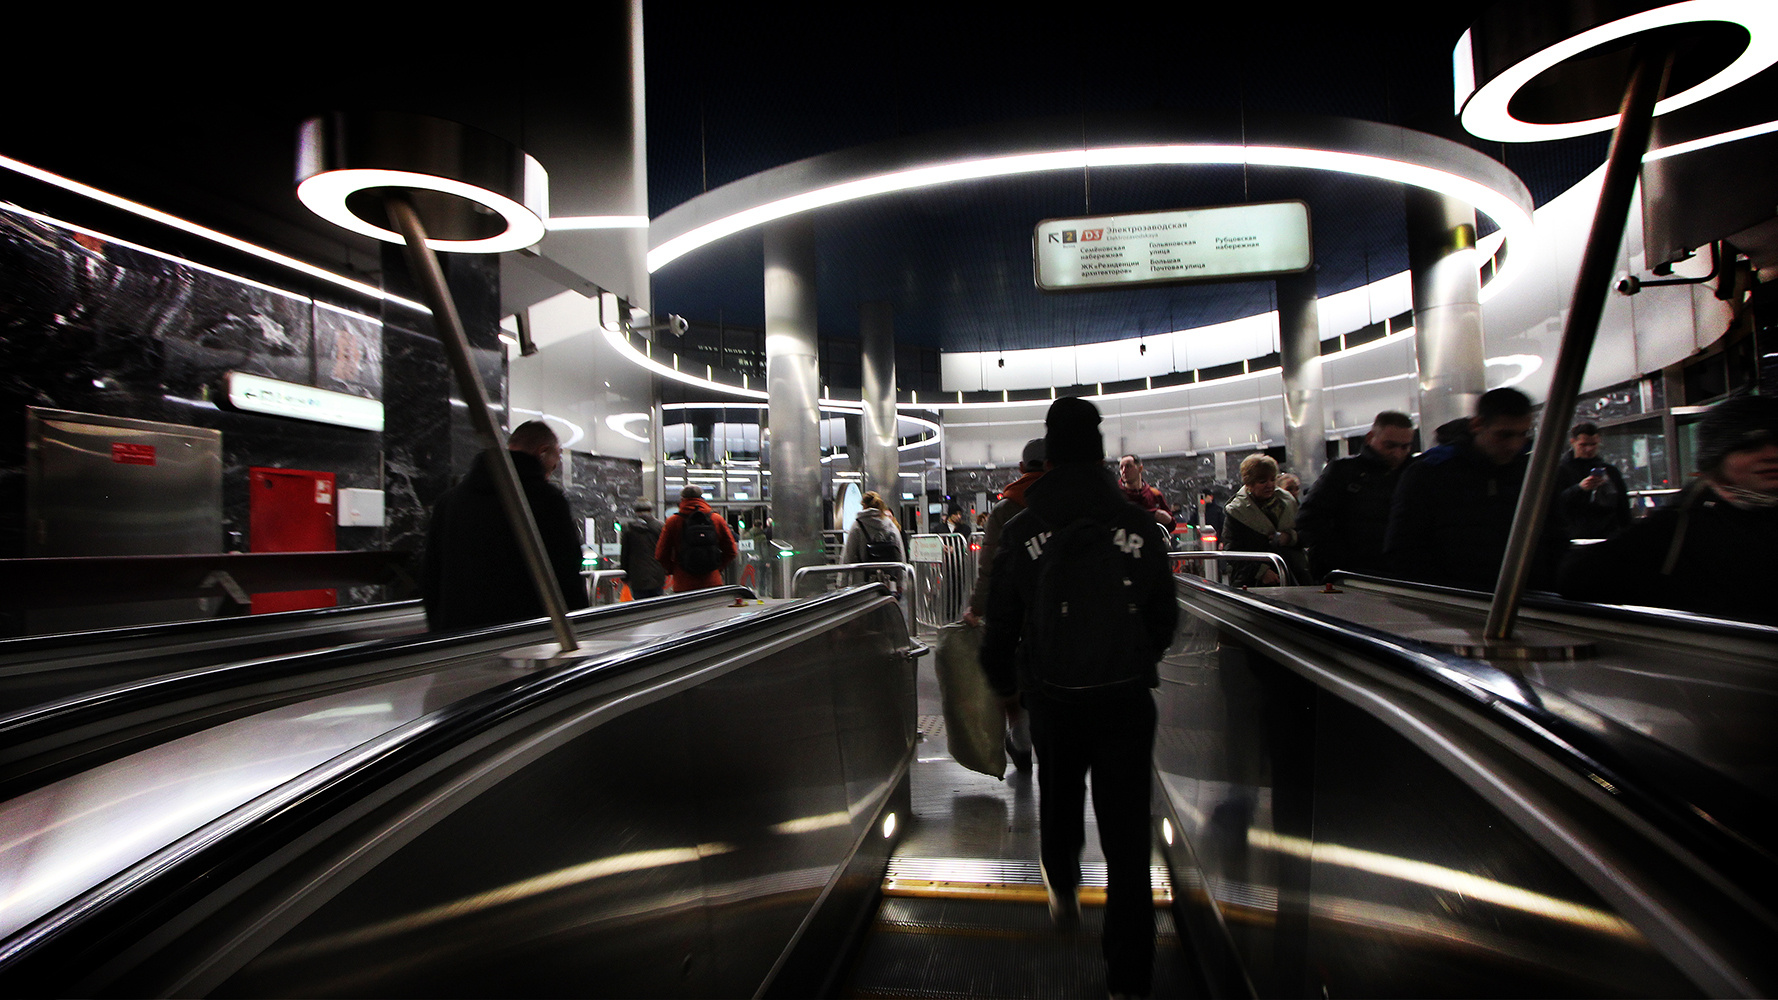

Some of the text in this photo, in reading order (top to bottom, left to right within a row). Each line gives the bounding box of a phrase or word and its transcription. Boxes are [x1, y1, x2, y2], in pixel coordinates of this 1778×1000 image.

[1085, 231, 1101, 241] D3
[1106, 222, 1188, 234] Электрозаводская
[1149, 240, 1197, 249] Гольяновская
[1215, 236, 1257, 245] Рубцовская
[1080, 245, 1126, 254] Семёновская
[1215, 242, 1260, 251] набережная
[1080, 252, 1123, 261] набережная
[1081, 262, 1094, 271] ЖК
[1150, 258, 1181, 266] Большая
[1150, 262, 1206, 273] Почтовая улица
